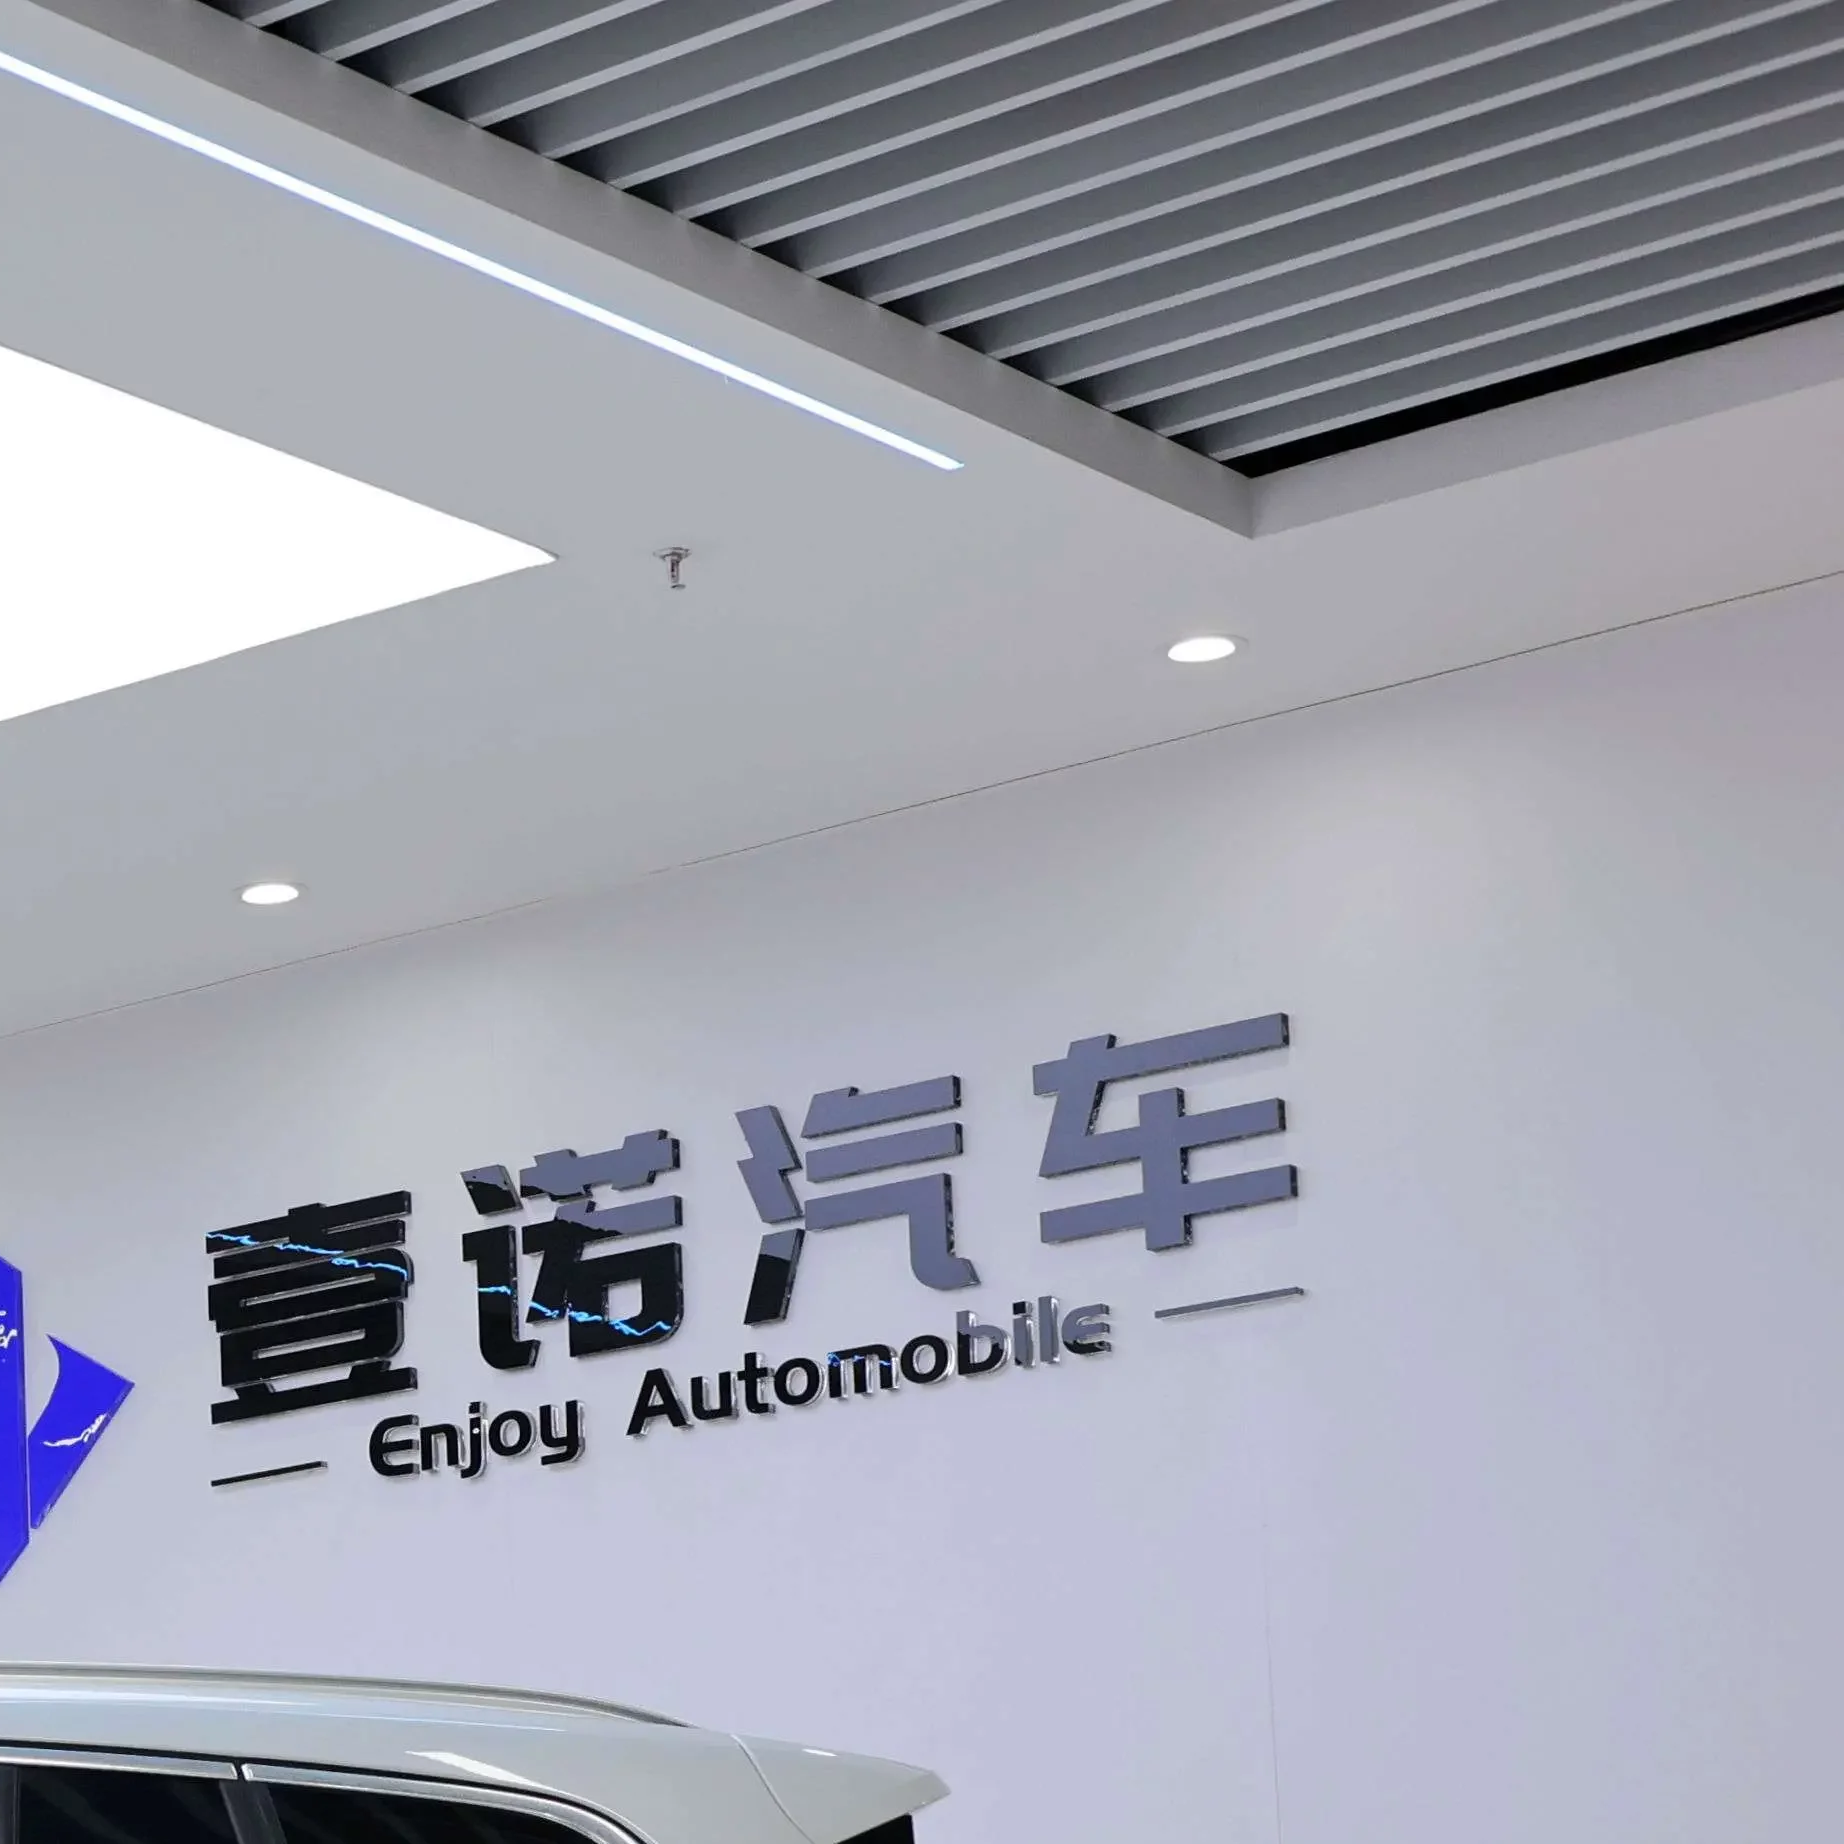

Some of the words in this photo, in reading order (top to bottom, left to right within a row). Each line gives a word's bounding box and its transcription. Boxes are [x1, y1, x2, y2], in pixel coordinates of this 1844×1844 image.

[205, 1011, 1299, 1425] 壹诺汽车
[368, 1399, 589, 1481] Enjoy
[626, 1294, 1112, 1438] Automobile
